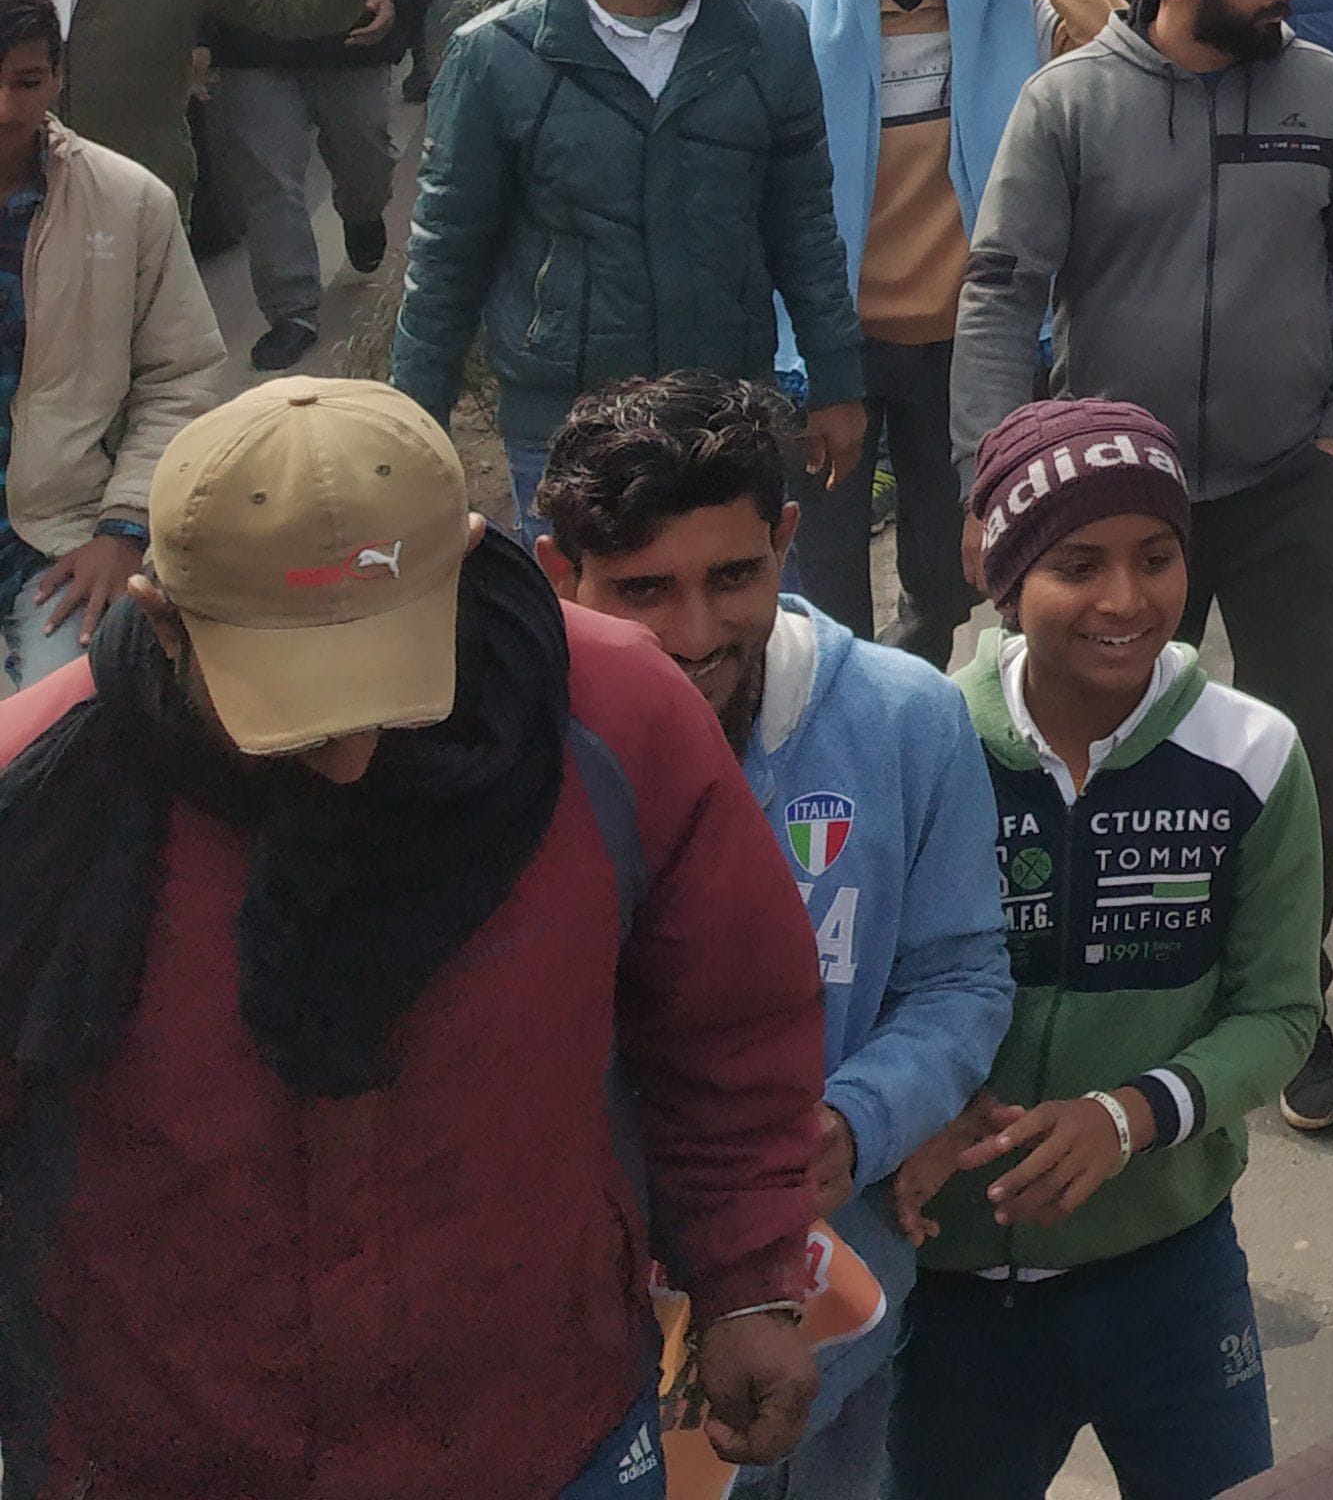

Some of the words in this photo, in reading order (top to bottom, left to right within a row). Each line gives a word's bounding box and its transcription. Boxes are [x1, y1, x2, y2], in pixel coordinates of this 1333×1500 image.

[794, 799, 846, 820] ITALIA
[1091, 809, 1232, 836] CTURING
[1095, 845, 1227, 872] TOMMY
[1091, 908, 1212, 933] HILFIGER
[619, 1453, 657, 1484] adidas
